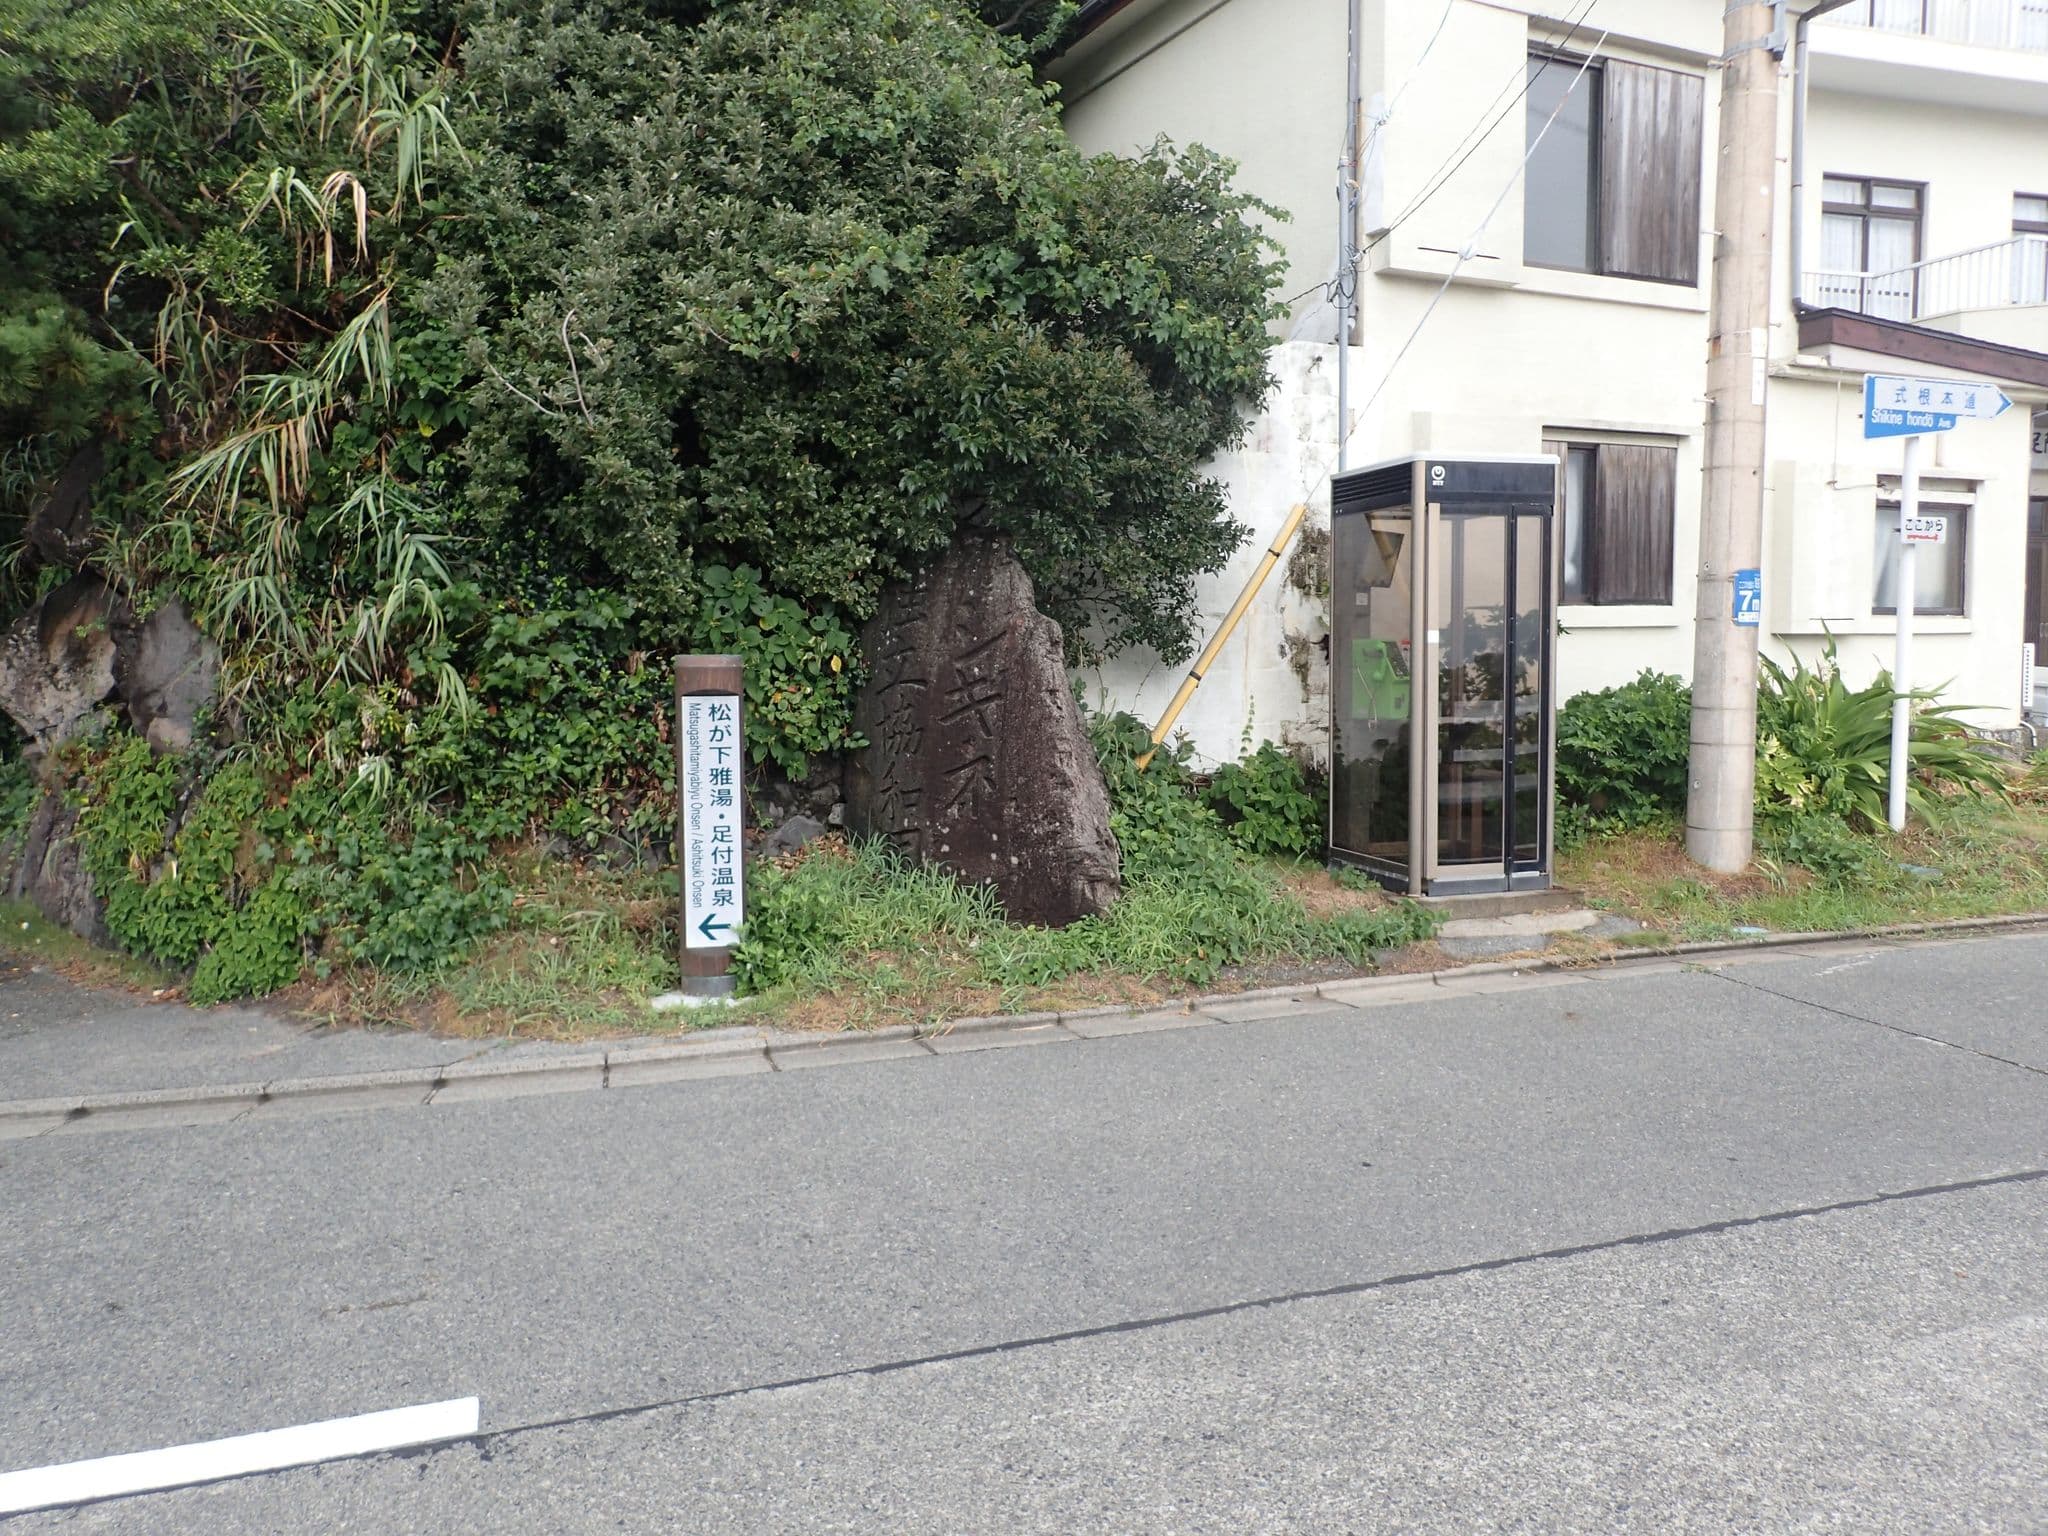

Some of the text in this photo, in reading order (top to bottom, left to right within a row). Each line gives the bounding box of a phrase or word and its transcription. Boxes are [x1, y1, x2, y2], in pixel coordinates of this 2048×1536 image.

[1894, 385, 1976, 410] 式根本道
[1871, 408, 1903, 425] Shikine
[1905, 518, 1943, 532] ここから
[691, 803, 703, 830] Onsen
[708, 703, 735, 907] 松が下雅湯・足付温泉
[691, 839, 704, 877] Ashitsuki
[692, 880, 704, 908] Onsen
